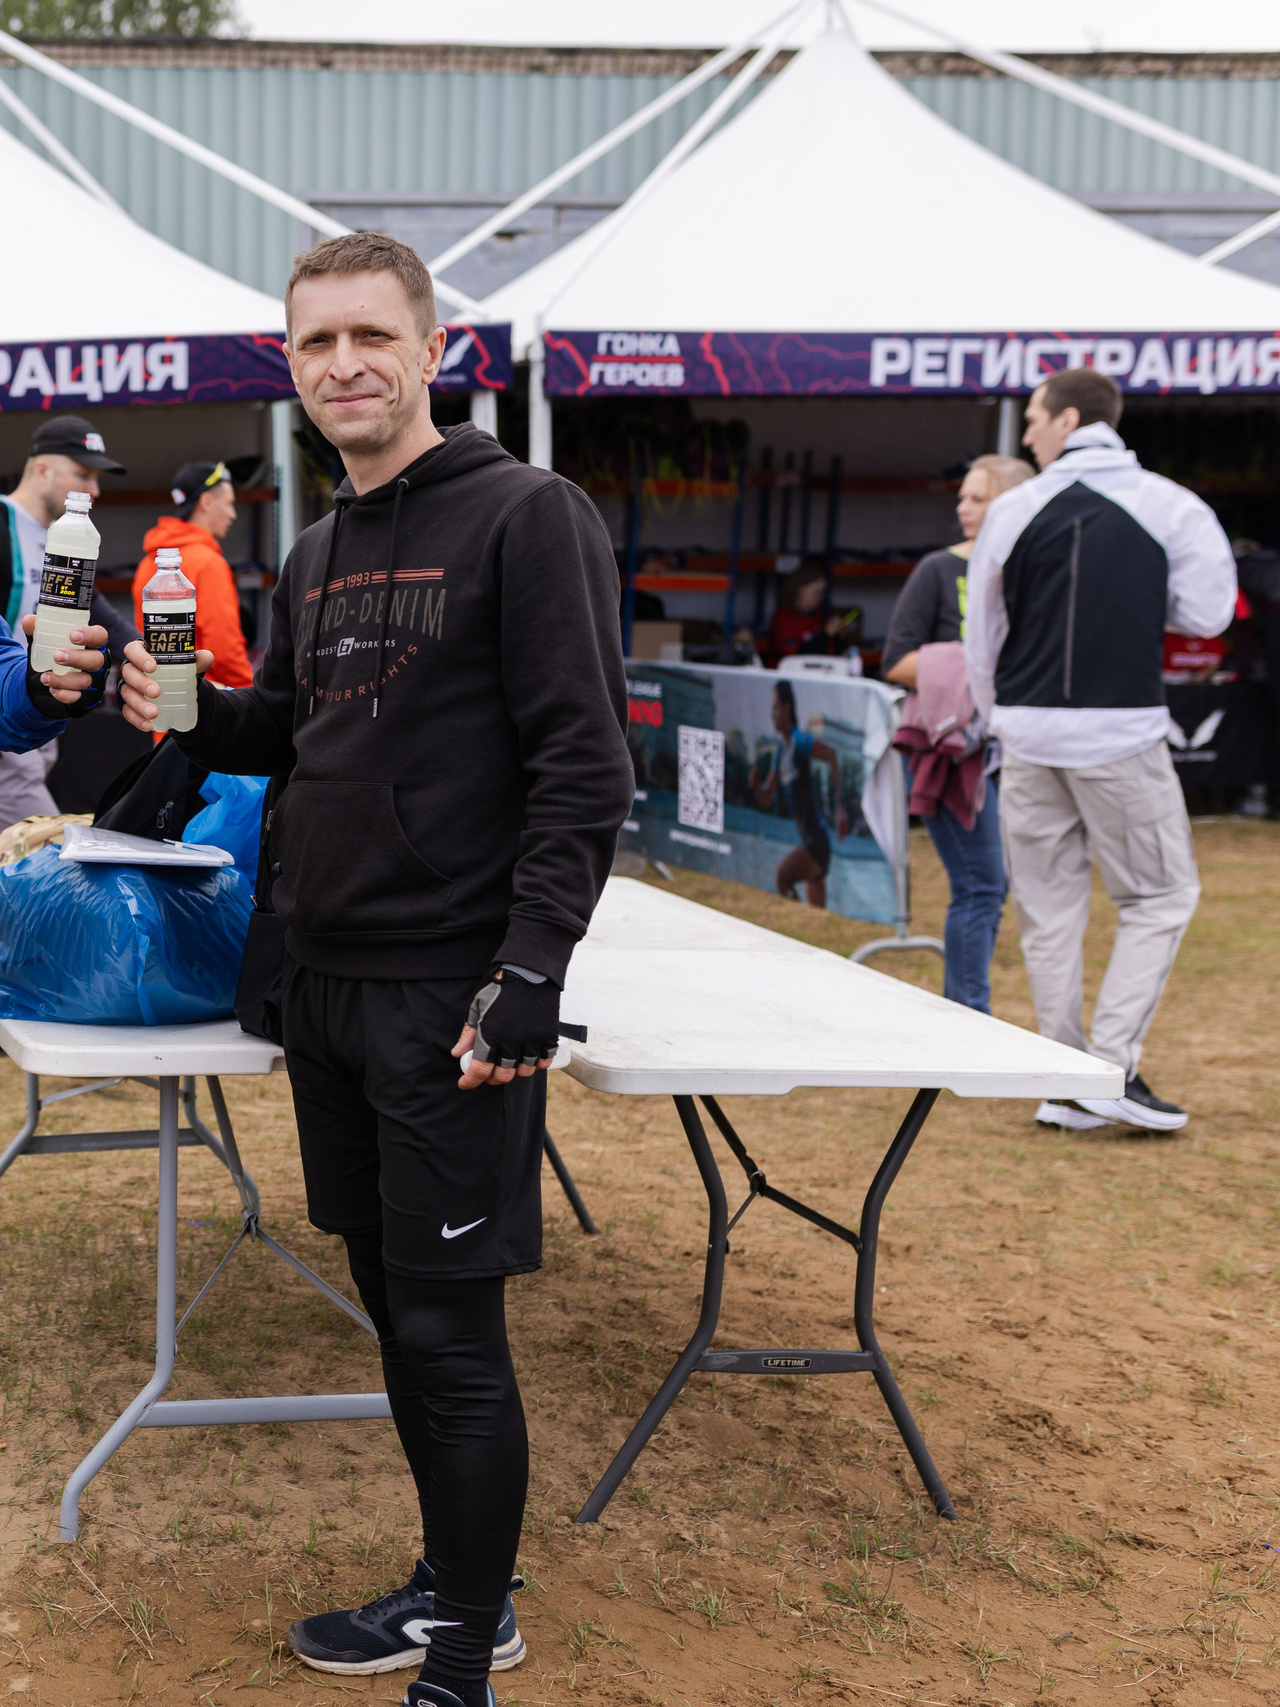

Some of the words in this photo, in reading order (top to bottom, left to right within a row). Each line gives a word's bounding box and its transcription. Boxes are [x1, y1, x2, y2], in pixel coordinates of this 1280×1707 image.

[597, 332, 681, 356] ГОНКА
[589, 362, 685, 387] ГЕРОЕВ
[43, 572, 74, 586] AFFE
[346, 571, 370, 588] 1993
[150, 632, 193, 642] CAFFE
[150, 642, 177, 652] INE
[307, 645, 337, 658] HRDEST
[354, 639, 396, 649] WORKRS
[767, 1359, 806, 1367] LIFETIME
